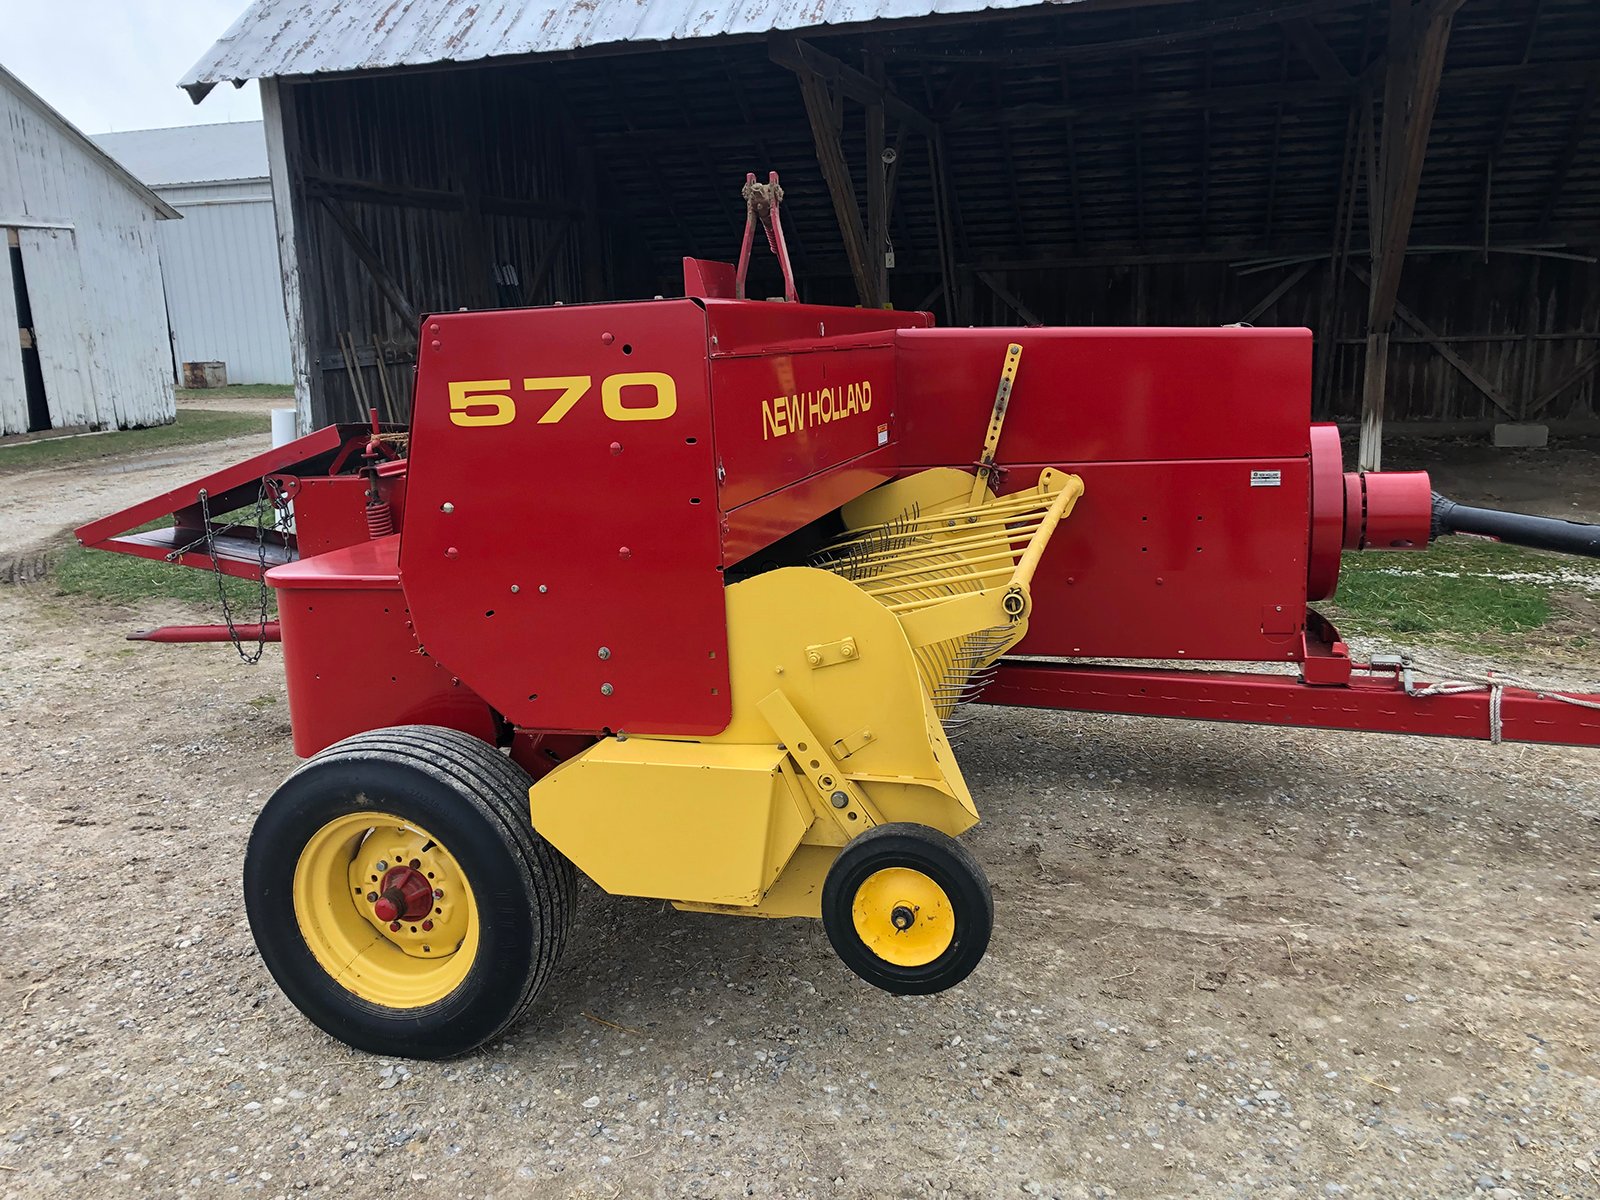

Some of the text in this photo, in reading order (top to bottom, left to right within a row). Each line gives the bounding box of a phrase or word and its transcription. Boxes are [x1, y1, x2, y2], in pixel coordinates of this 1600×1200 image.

[448, 372, 677, 427] 570
[762, 381, 872, 440] NEW HOLLAND
